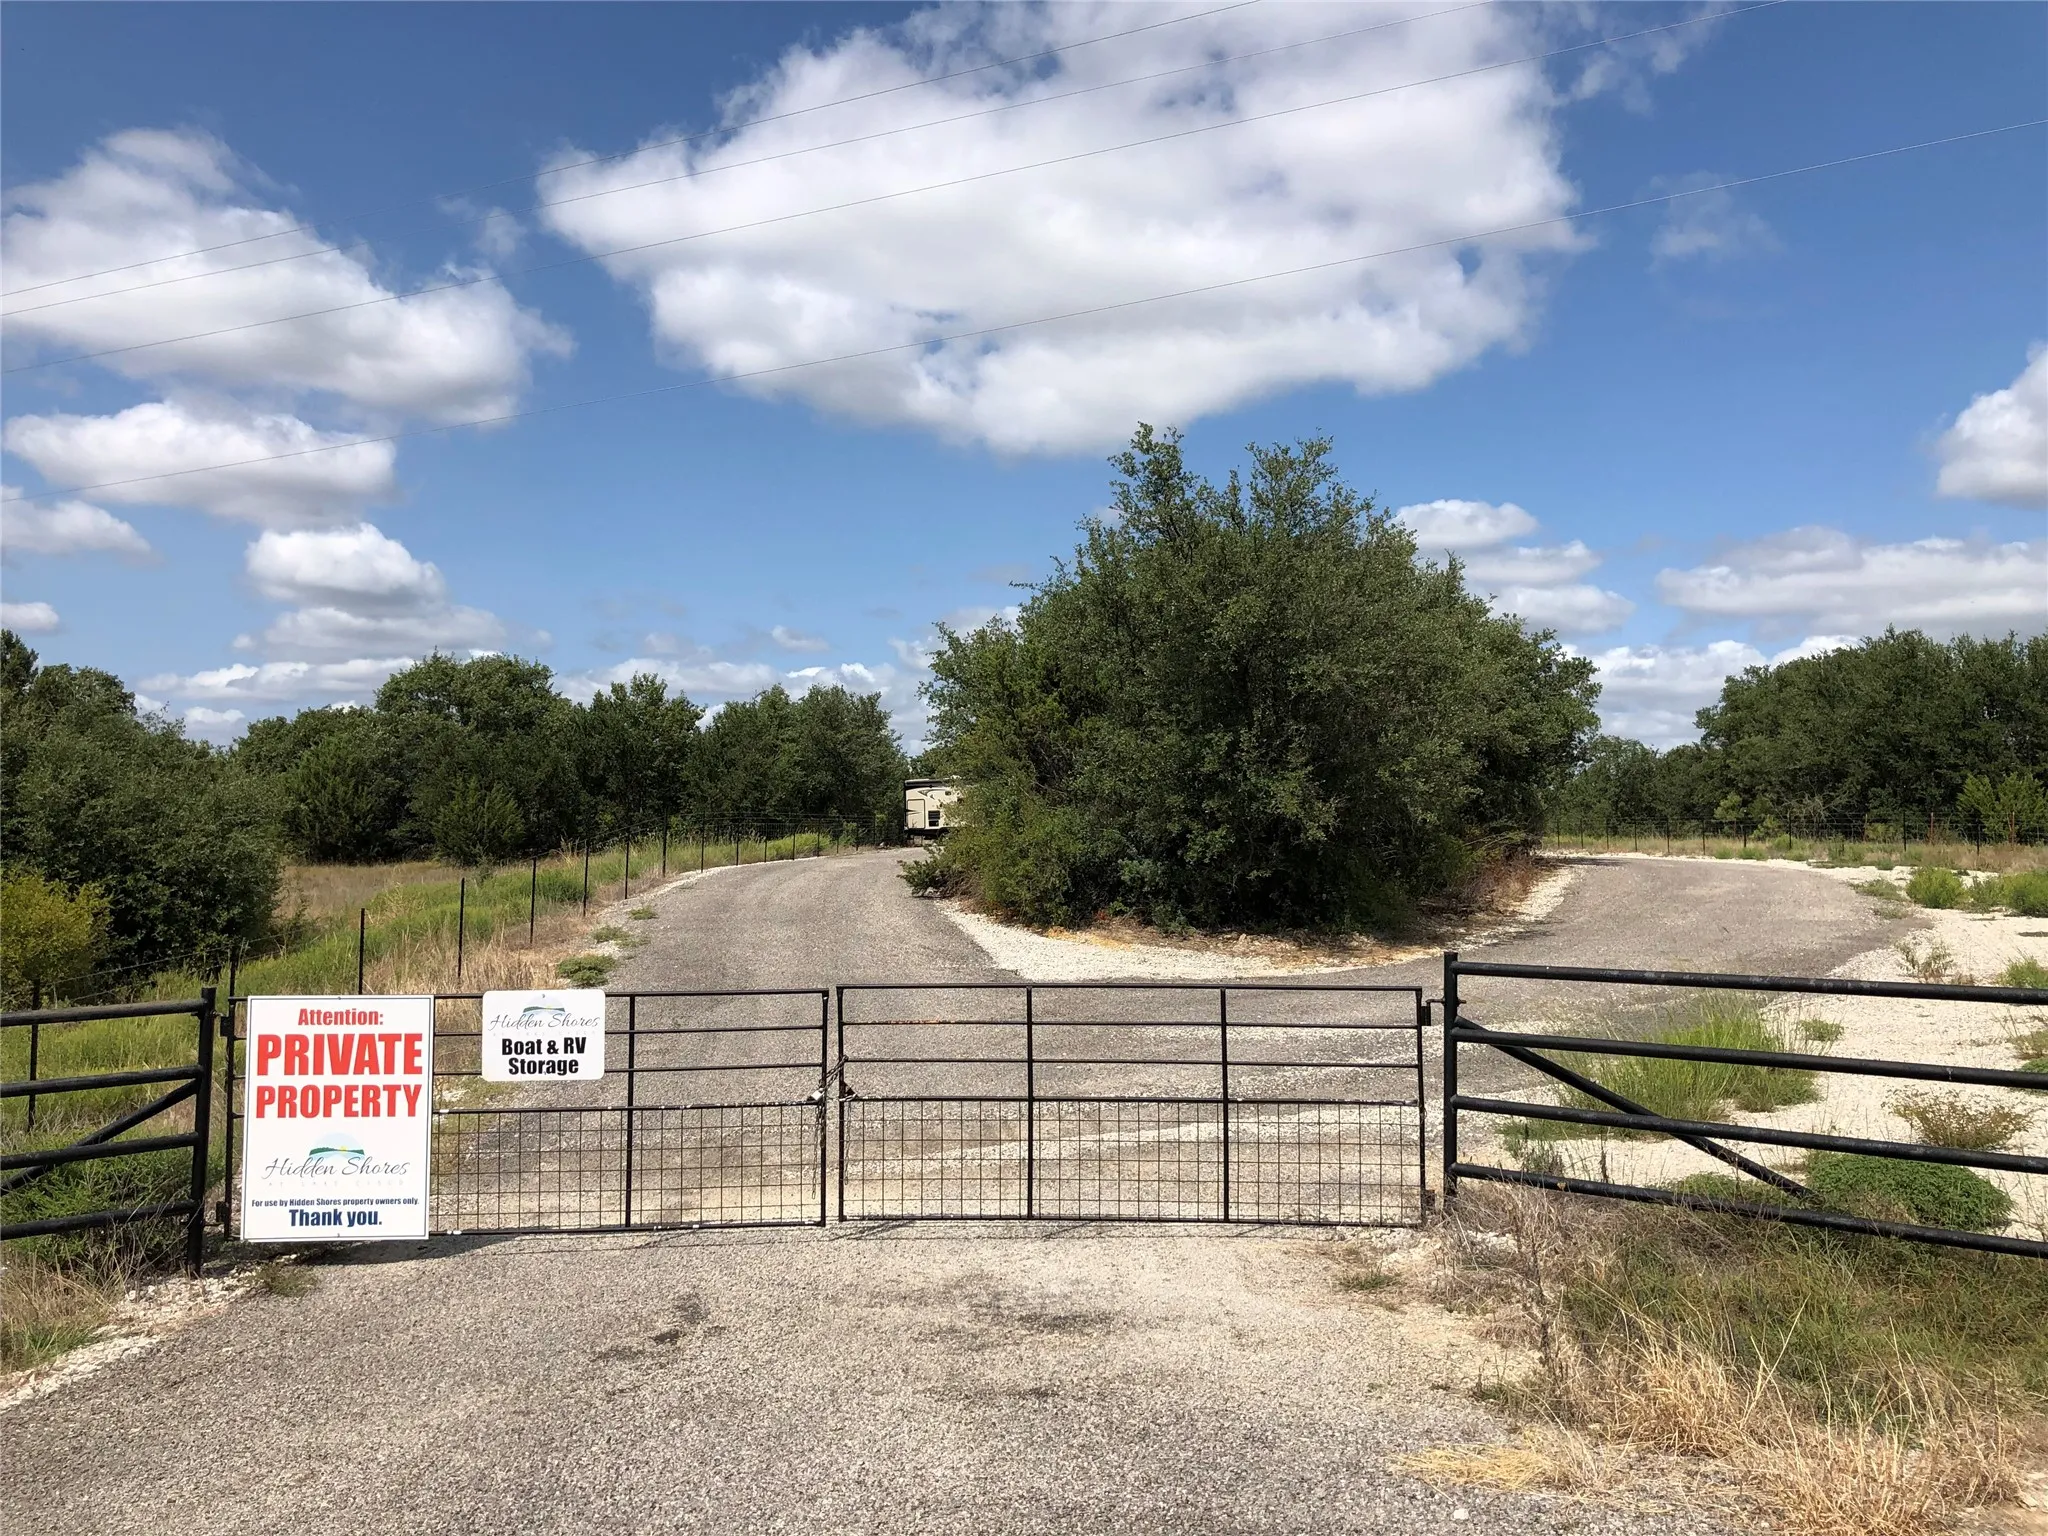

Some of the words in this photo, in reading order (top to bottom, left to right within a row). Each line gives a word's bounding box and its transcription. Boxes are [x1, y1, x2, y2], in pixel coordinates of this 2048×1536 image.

[297, 1008, 384, 1026] Attention:
[487, 1013, 545, 1031] Hidden
[548, 1012, 601, 1028] Shores
[256, 1032, 423, 1077] PRIVATE
[501, 1037, 543, 1055] Boat
[546, 1039, 559, 1055] &
[563, 1036, 587, 1054] RV
[508, 1056, 579, 1076] Storage
[255, 1083, 423, 1119] PROPERTY
[261, 1156, 337, 1180] Hidden
[341, 1155, 411, 1176] Shores
[251, 1199, 263, 1207] For
[279, 1199, 288, 1207] by
[289, 1198, 315, 1206] Hidden
[316, 1198, 342, 1206] Shores
[342, 1197, 374, 1207] property
[375, 1197, 402, 1205] owners
[402, 1197, 420, 1206] only.
[288, 1208, 343, 1227] Thank
[346, 1210, 383, 1227] you.
